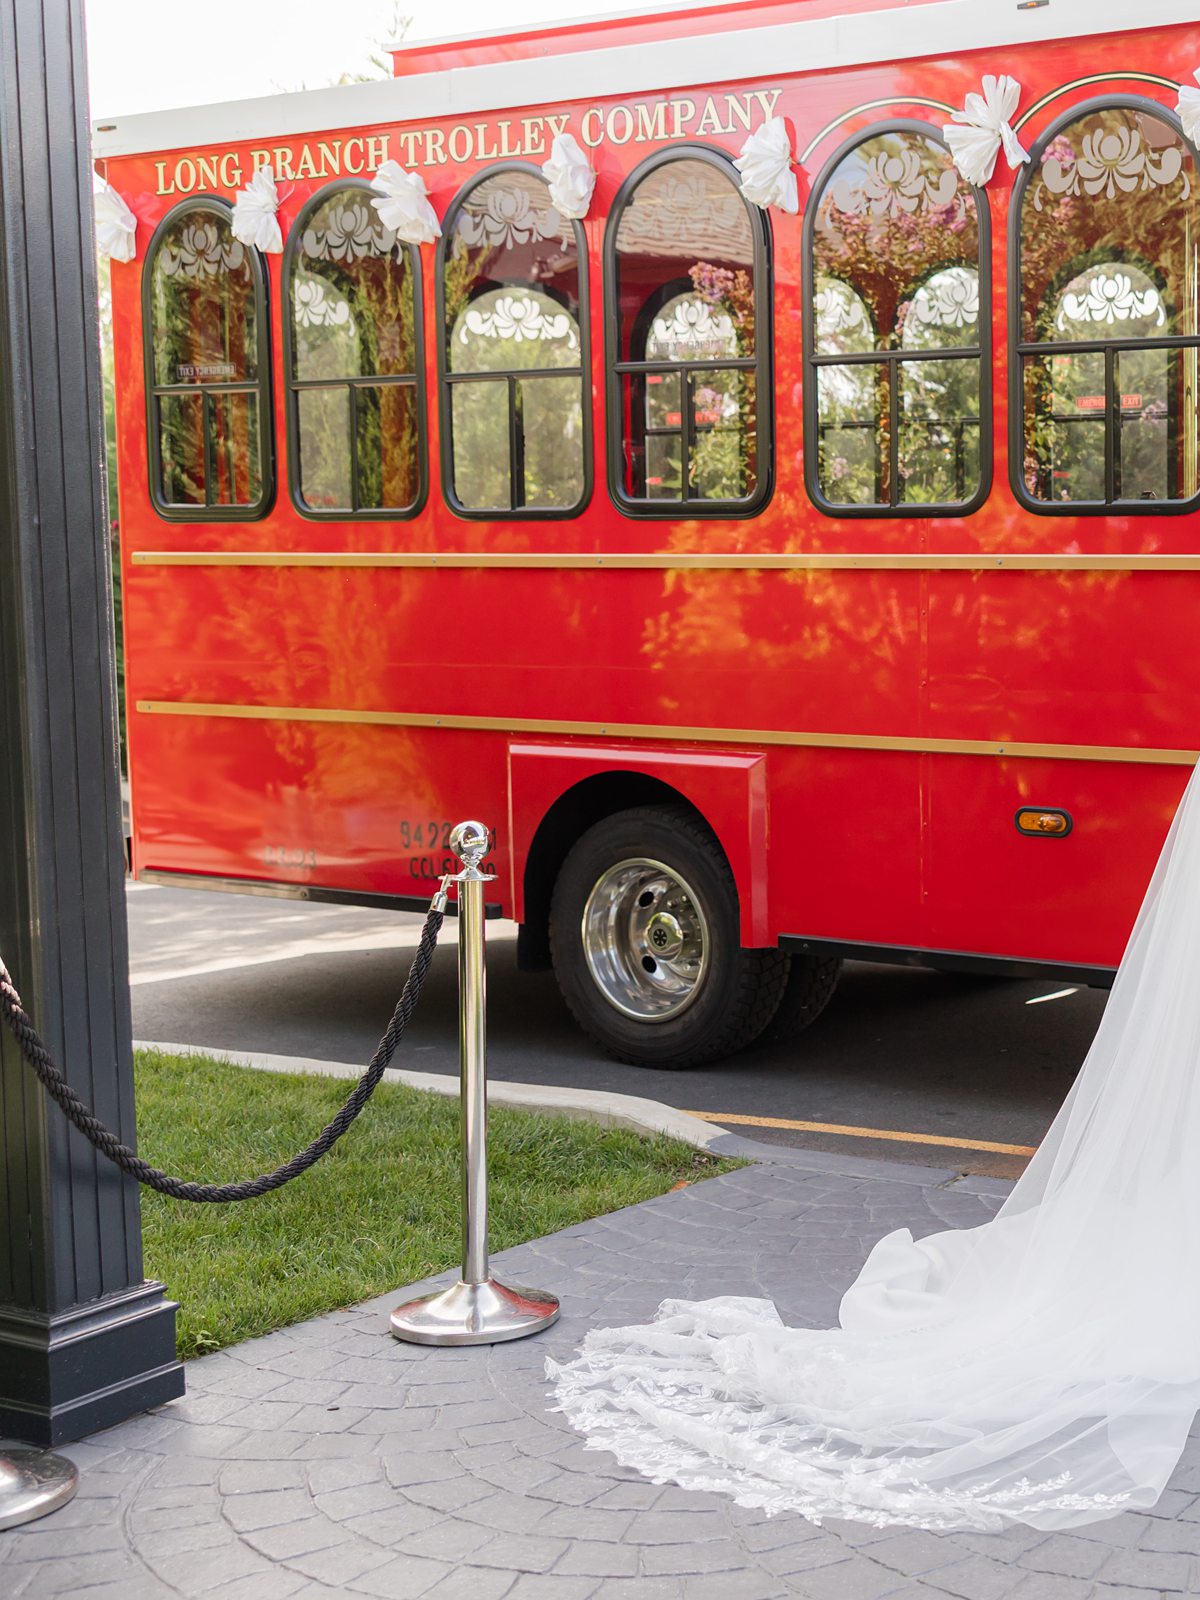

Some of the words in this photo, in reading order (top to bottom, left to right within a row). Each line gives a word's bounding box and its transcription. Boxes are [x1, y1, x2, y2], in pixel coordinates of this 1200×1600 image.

[155, 152, 243, 196] LONG
[400, 114, 571, 168] TROLLEY
[580, 88, 783, 148] COMPANY
[1122, 396, 1140, 407] EXIT
